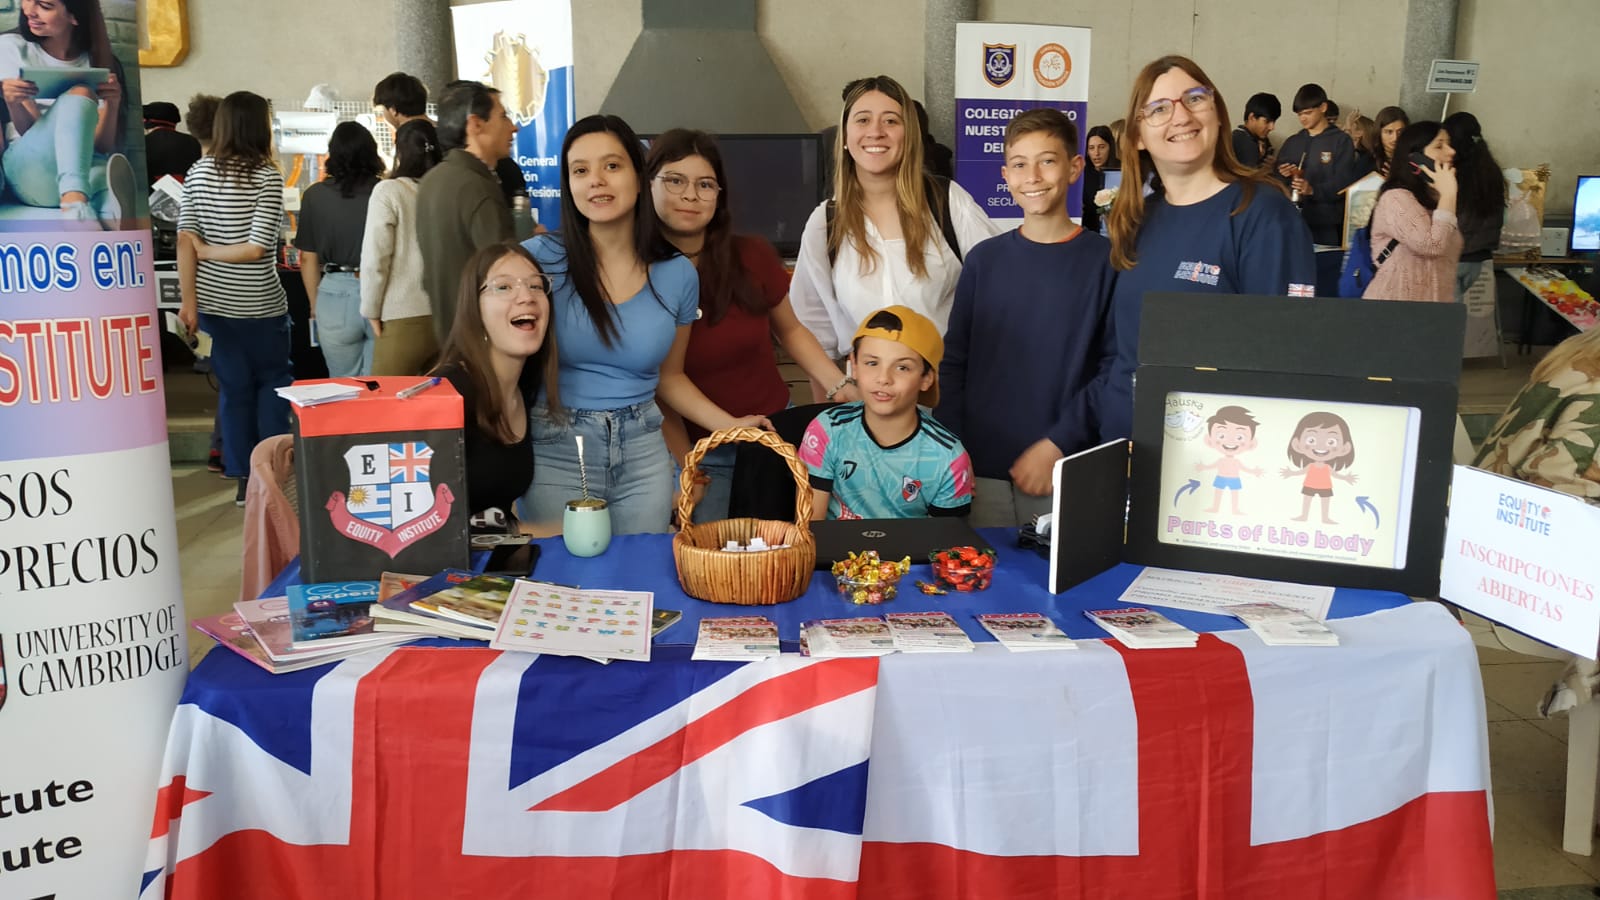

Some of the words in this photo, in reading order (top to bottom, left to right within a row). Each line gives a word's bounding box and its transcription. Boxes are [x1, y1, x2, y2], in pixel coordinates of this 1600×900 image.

[519, 155, 558, 167] General
[521, 170, 539, 182] ón
[987, 197, 1017, 207] SECU
[91, 240, 145, 290] en:
[0, 314, 157, 404] STITUTE
[361, 454, 376, 475] E
[404, 492, 414, 512] I
[345, 520, 384, 543] EQUITY
[397, 510, 443, 543] INSTITUTE
[1167, 515, 1233, 540] Parts
[1238, 524, 1263, 542] of
[1268, 526, 1309, 546] the
[1314, 530, 1375, 556] body
[1496, 508, 1551, 536] INSTITUTE
[1459, 539, 1595, 602] INSCRIPCIONES
[1477, 576, 1563, 622] ABIERTAS
[16, 611, 152, 659] UNIVERSITY
[156, 604, 177, 635] OF
[18, 634, 183, 697] CAMBRIDGE
[0, 836, 82, 872] ute
